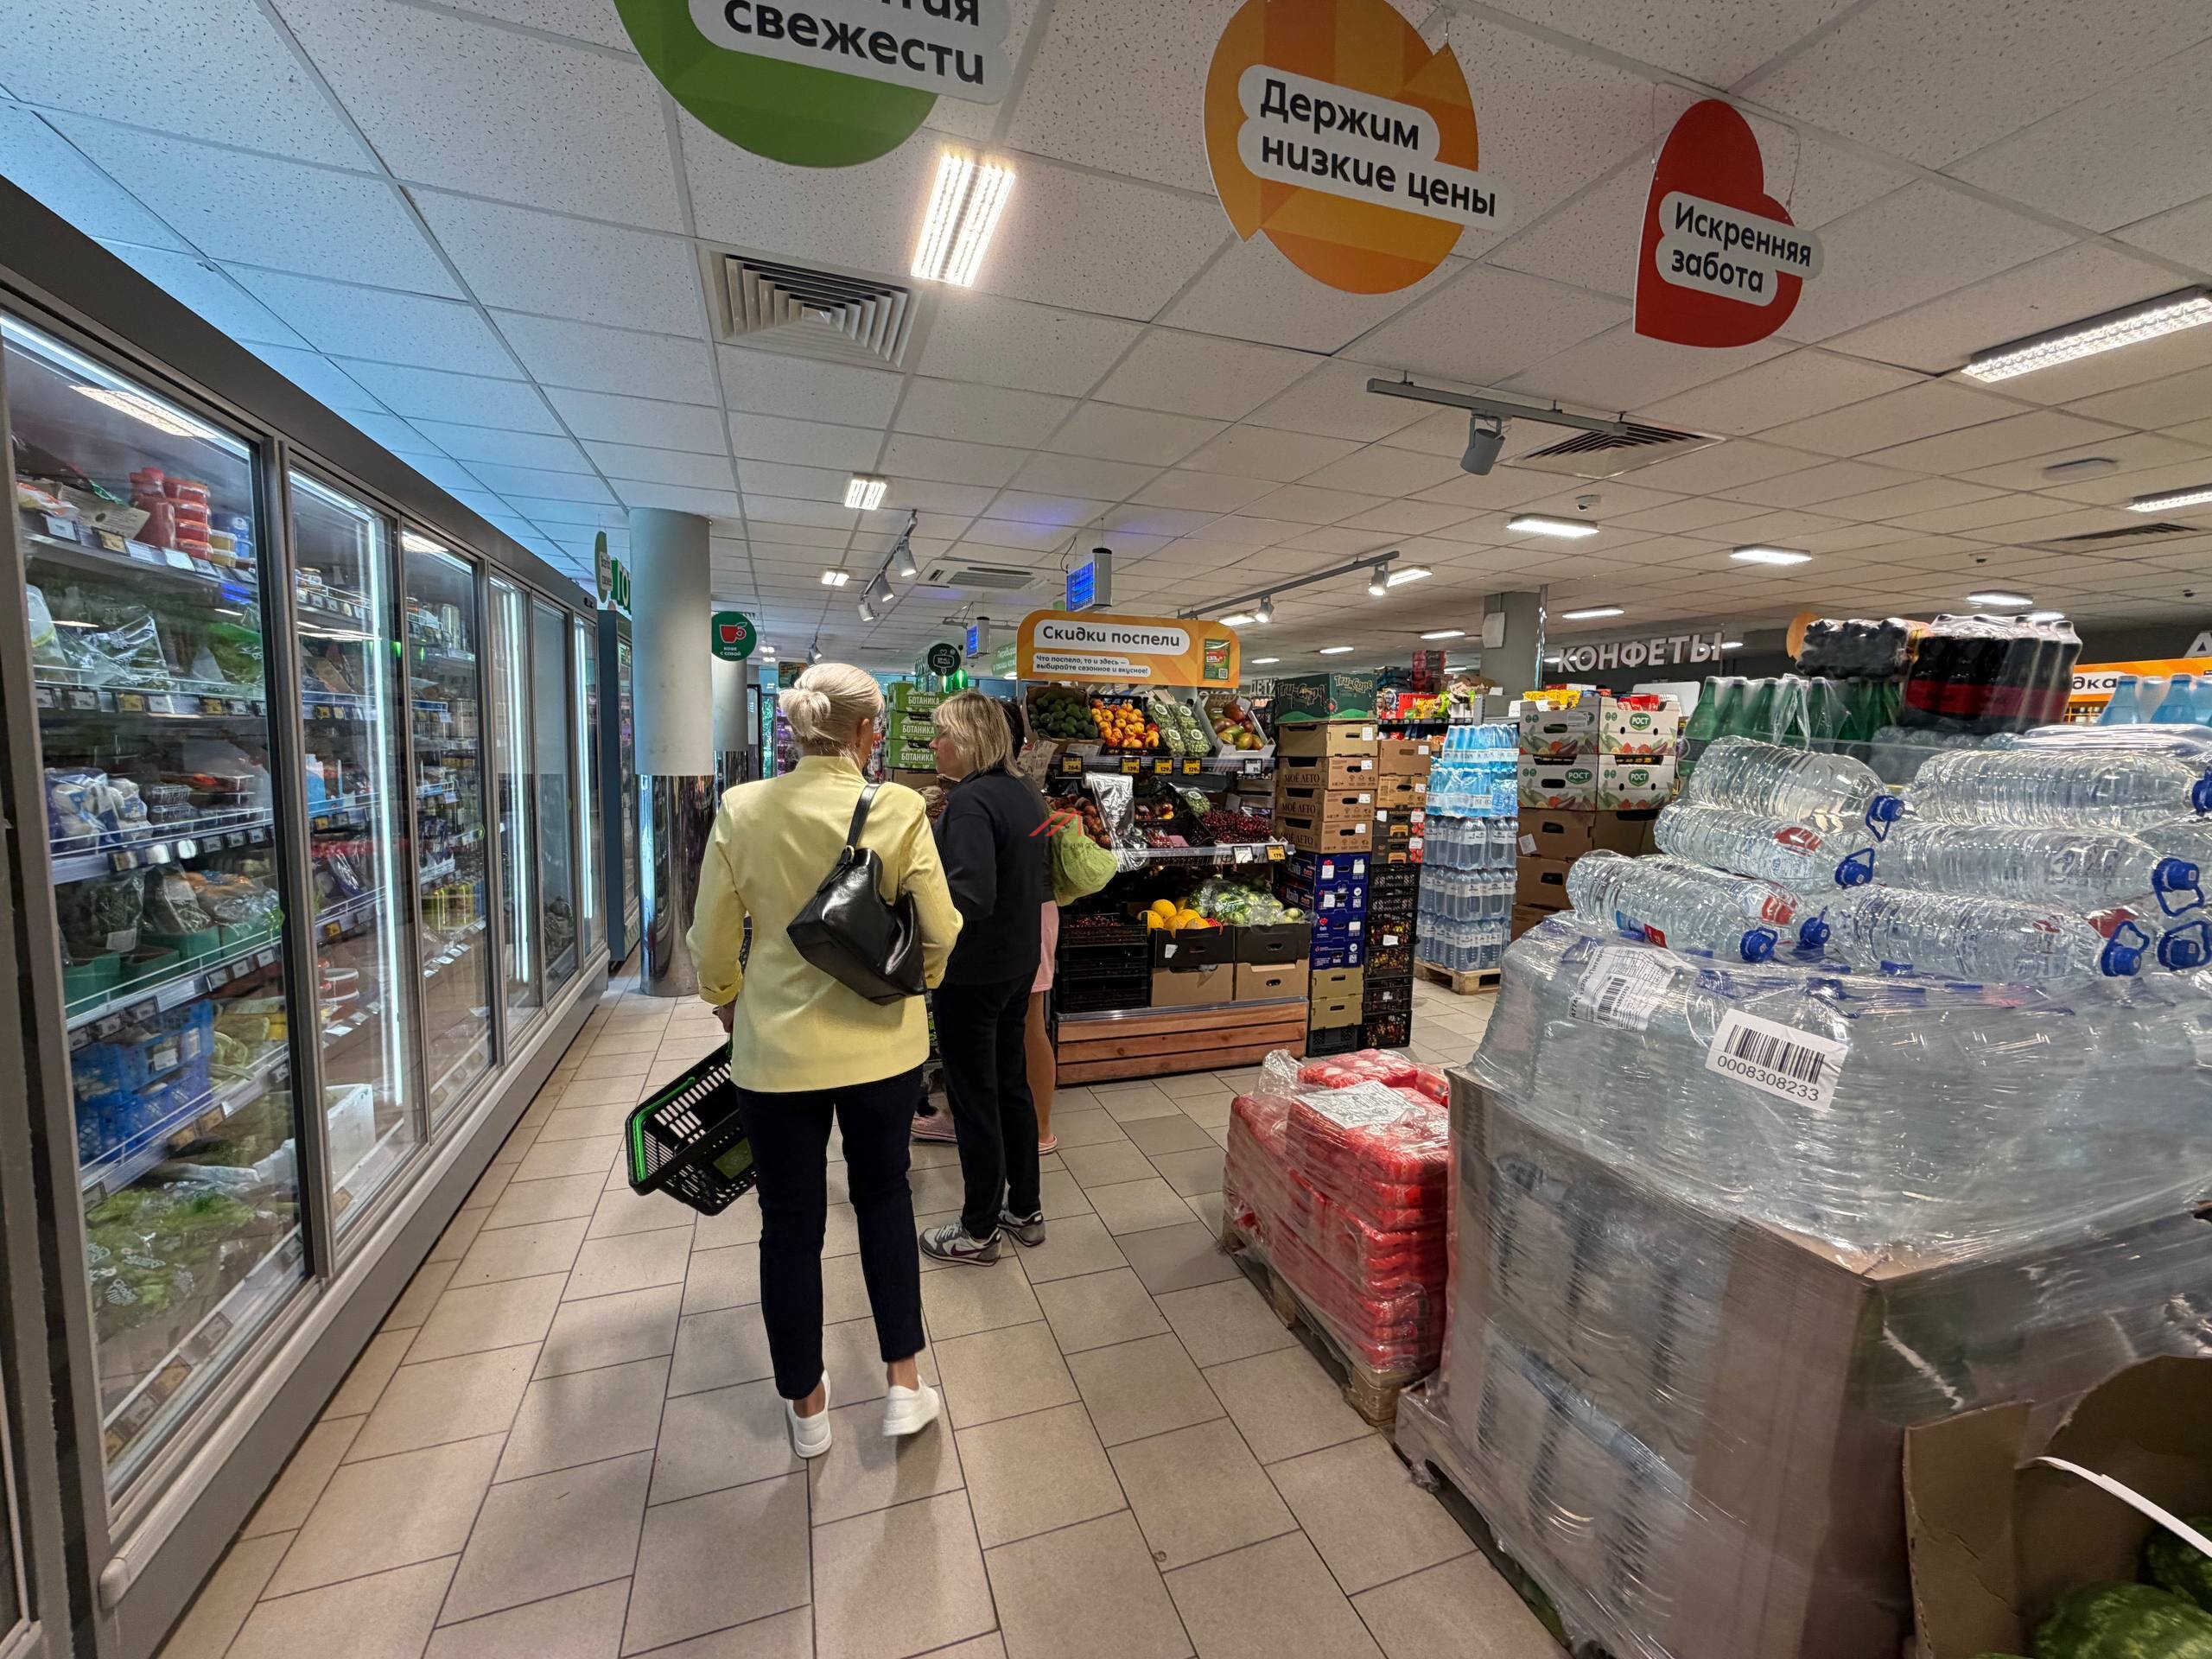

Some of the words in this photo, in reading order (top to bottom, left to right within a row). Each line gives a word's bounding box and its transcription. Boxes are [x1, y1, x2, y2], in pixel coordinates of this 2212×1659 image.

[723, 0, 983, 85] свежести
[1261, 79, 1420, 151] Держим
[1262, 135, 1396, 193] низкие
[1408, 168, 1497, 218] цены
[1675, 201, 1813, 268] Искренняя
[1671, 245, 1764, 294] забота
[1042, 625, 1107, 643] Скидки
[1111, 632, 1180, 648] поспели
[1557, 632, 1724, 673] КОНФЕТЫ
[1036, 654, 1050, 663] Что
[1051, 656, 1083, 666] поспело,
[1036, 663, 1076, 673] выбирайте
[1077, 665, 1109, 674] сезонное
[1118, 666, 1148, 676] вкусное!
[1334, 675, 1374, 694] Tru-Cape
[2072, 676, 2118, 690] дка
[907, 695, 940, 705] БОТАНИКА
[1631, 716, 1649, 726] РОСТ
[902, 724, 935, 734] БОТАНИКА
[901, 753, 934, 762] БОТАНИКА
[1284, 772, 1300, 783] МОЁ
[1300, 773, 1320, 783] ЛЕТО
[1567, 771, 1590, 780] РОСТ
[1630, 772, 1648, 782] РОСТ
[1282, 802, 1296, 813] МОЁ
[1297, 804, 1316, 814] ЛЕТО
[1716, 1054, 1821, 1103] 0008308233
